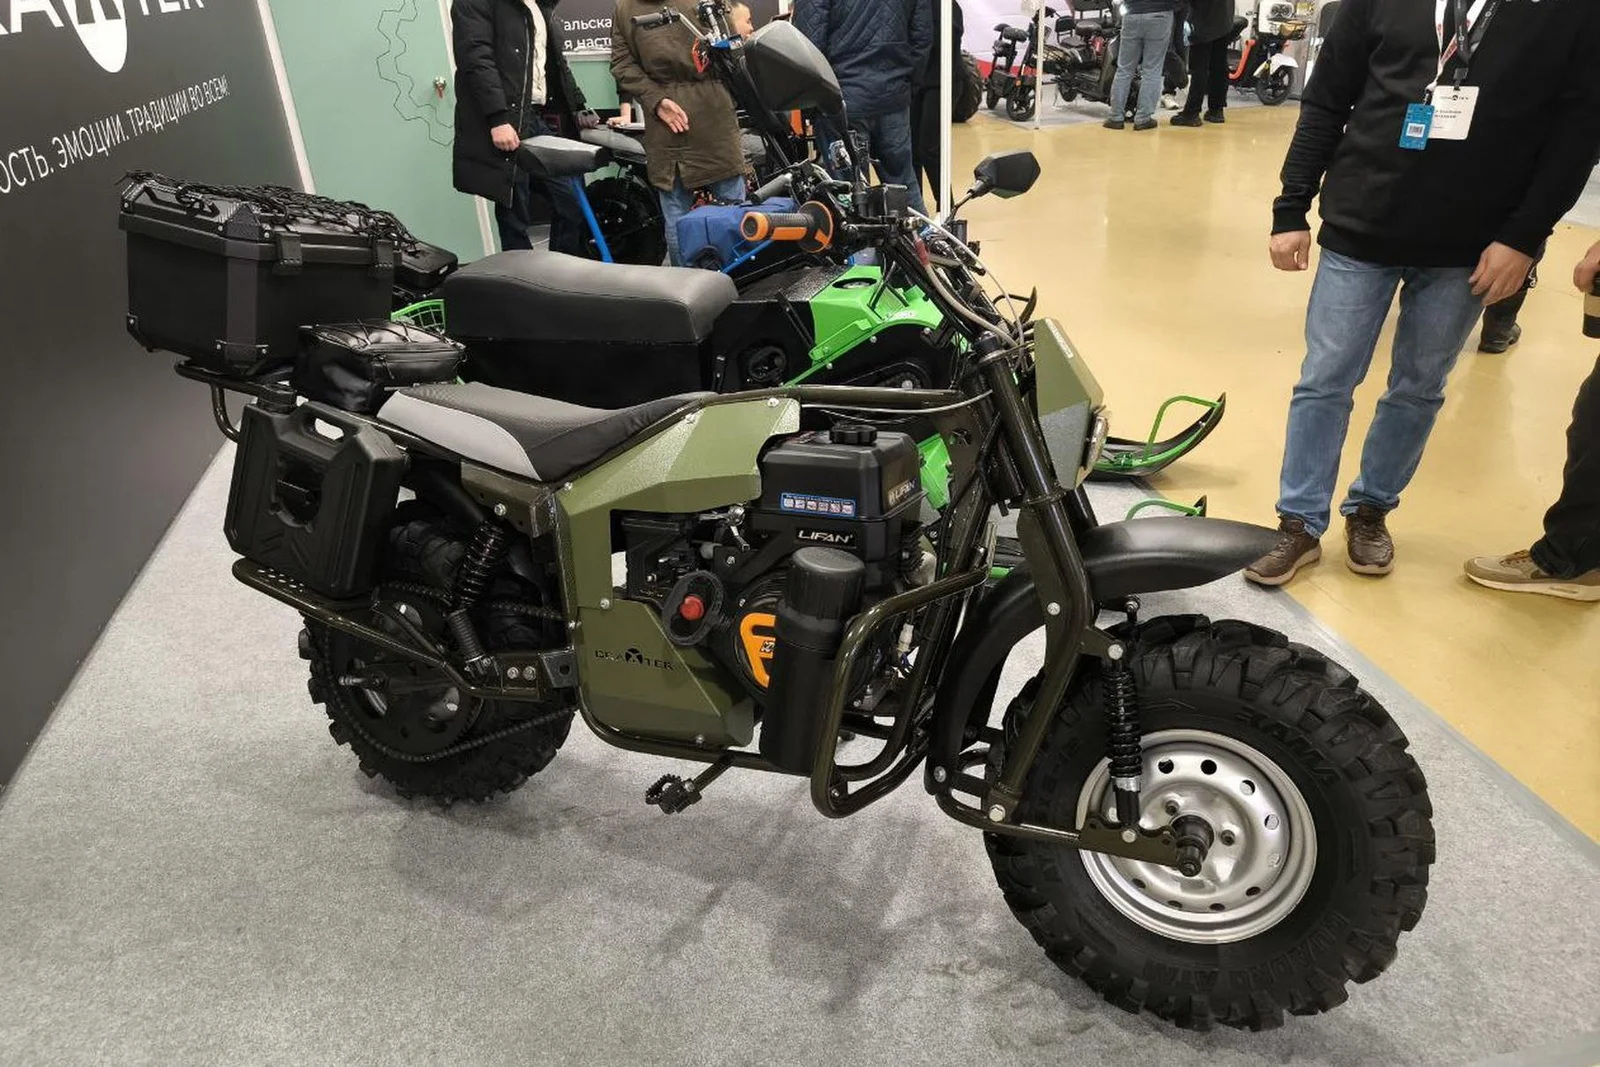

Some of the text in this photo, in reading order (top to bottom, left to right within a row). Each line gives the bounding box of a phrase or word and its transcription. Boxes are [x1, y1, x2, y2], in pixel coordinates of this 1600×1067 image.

[51, 114, 130, 169] ЭМОЦИИ.
[126, 90, 190, 136] ТРАДИЦИИ
[188, 84, 204, 111] ВО
[798, 530, 849, 543] LIFAN
